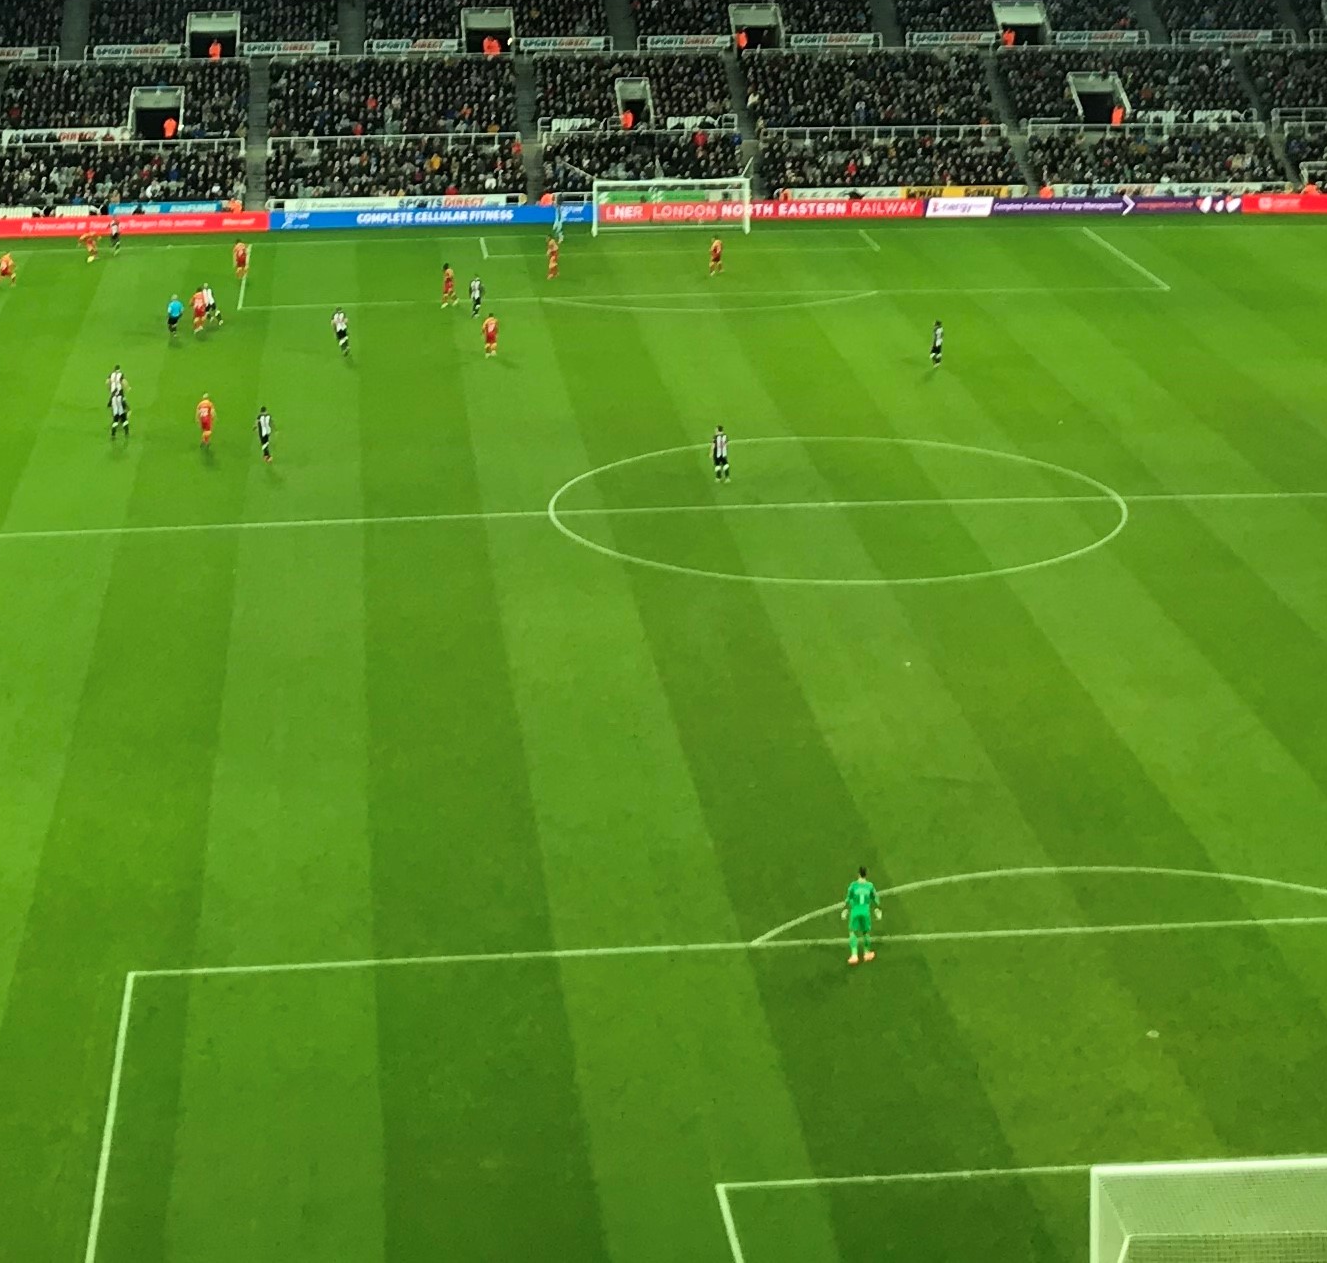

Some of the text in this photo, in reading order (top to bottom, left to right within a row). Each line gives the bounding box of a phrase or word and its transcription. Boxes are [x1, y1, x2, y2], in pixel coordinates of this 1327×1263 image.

[356, 208, 515, 225] COMPLETE CELLULAR FITNESS
[652, 204, 718, 220] LONDON
[778, 201, 847, 216] EASTERN
[850, 201, 919, 215] RAILWAY
